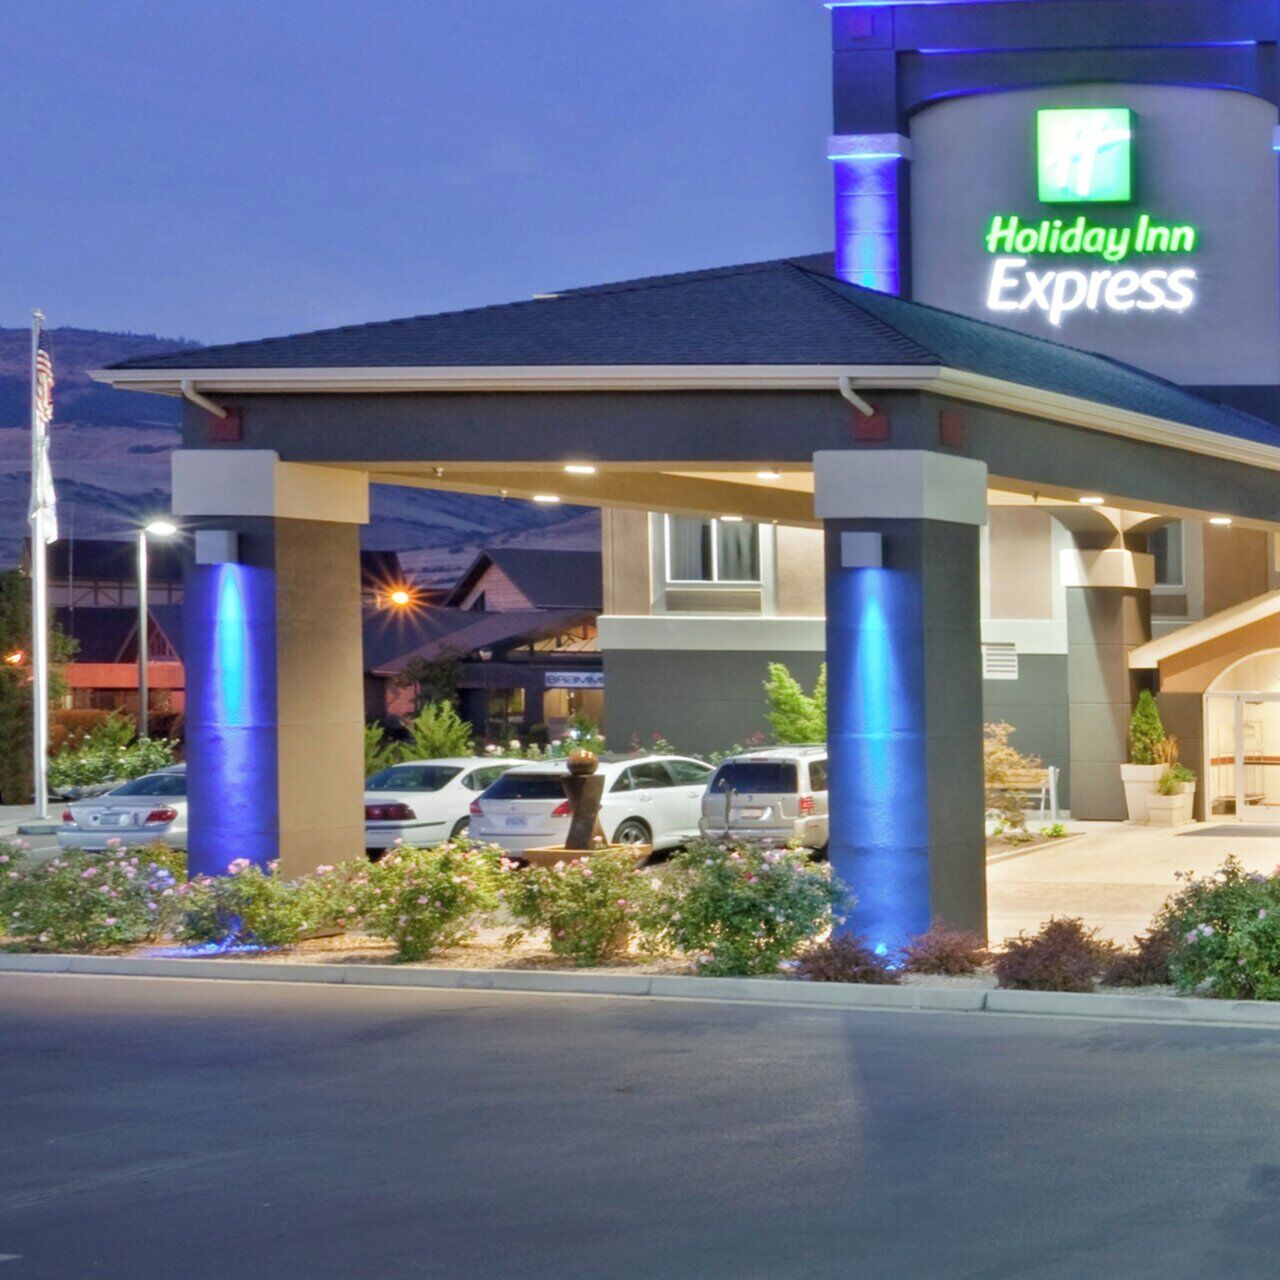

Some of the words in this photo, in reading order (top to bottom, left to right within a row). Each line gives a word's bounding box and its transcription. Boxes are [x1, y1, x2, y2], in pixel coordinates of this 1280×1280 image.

[985, 216, 1132, 261] Holiday
[1134, 214, 1196, 253] Inn
[986, 258, 1198, 325] Express
